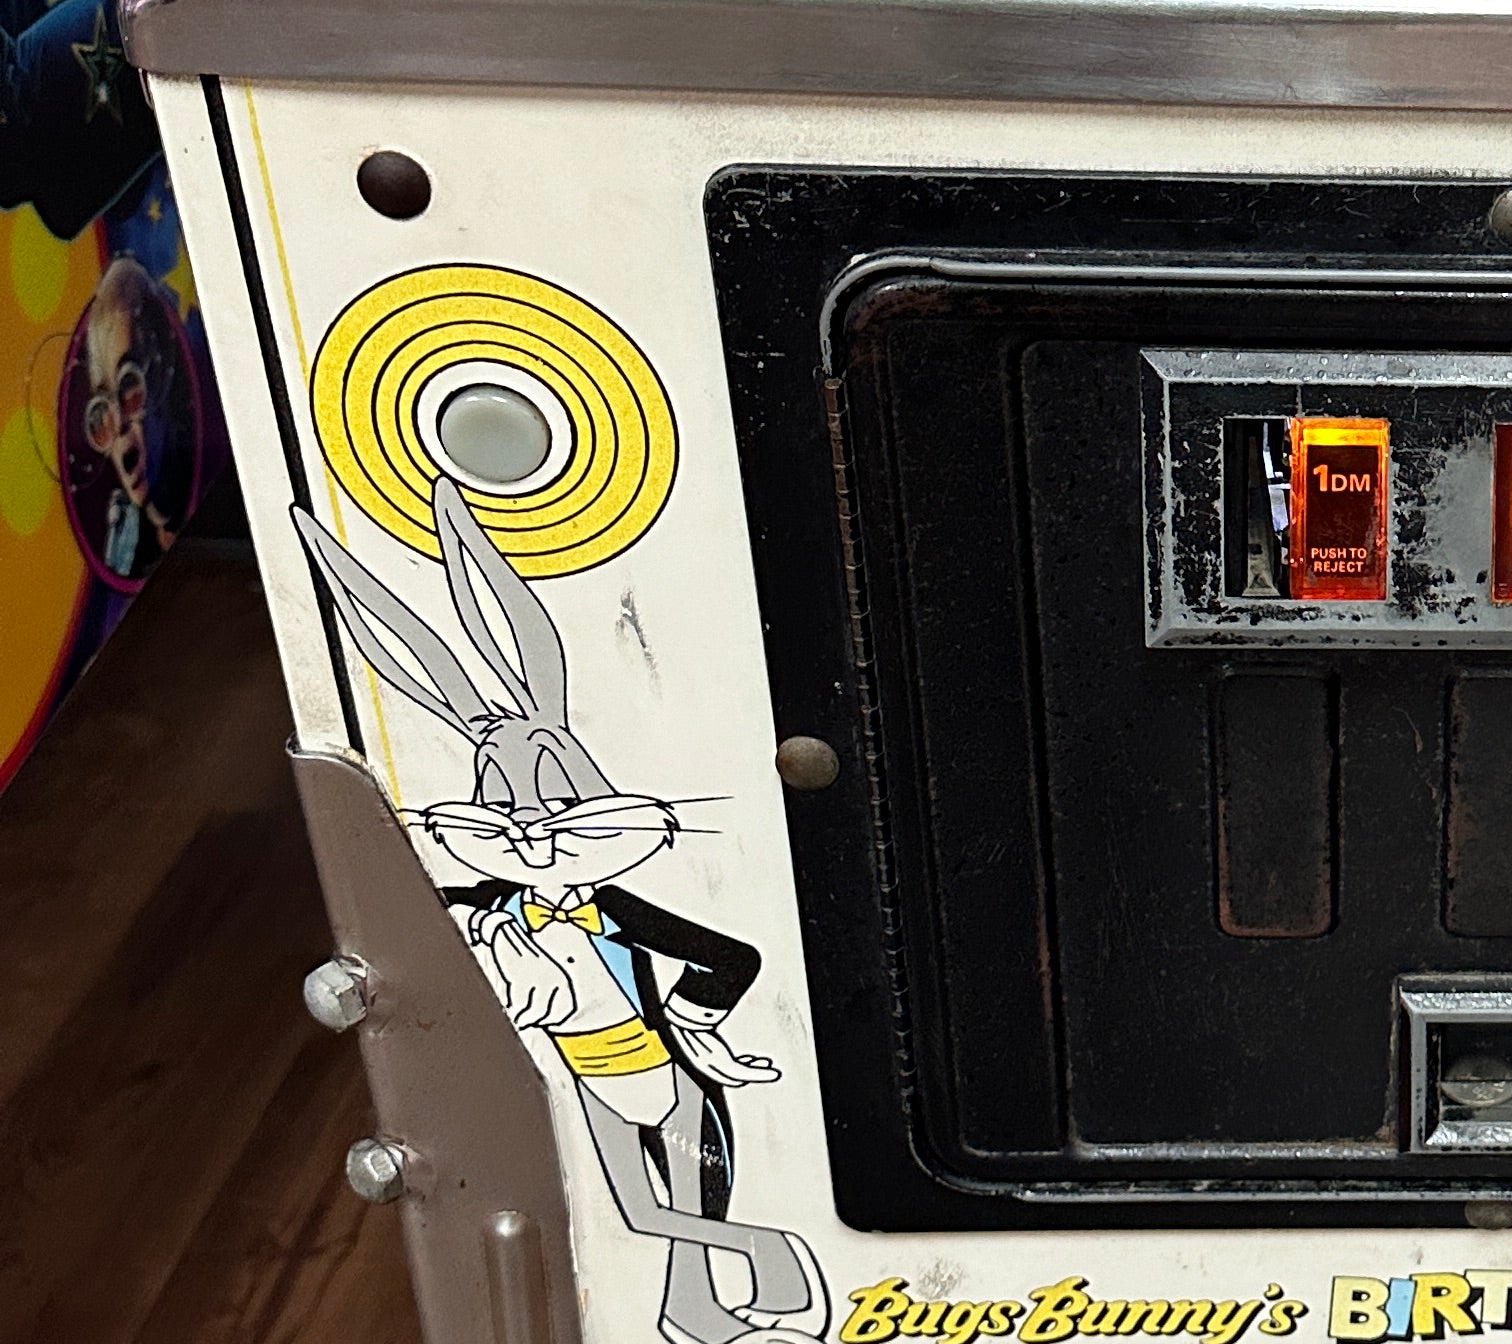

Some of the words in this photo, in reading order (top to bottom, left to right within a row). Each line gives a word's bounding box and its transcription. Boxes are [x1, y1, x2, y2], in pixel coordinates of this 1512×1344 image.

[1313, 464, 1371, 493] 1DM
[1311, 547, 1347, 561] PUSH
[1348, 547, 1368, 561] TO
[1313, 560, 1366, 574] REJECT
